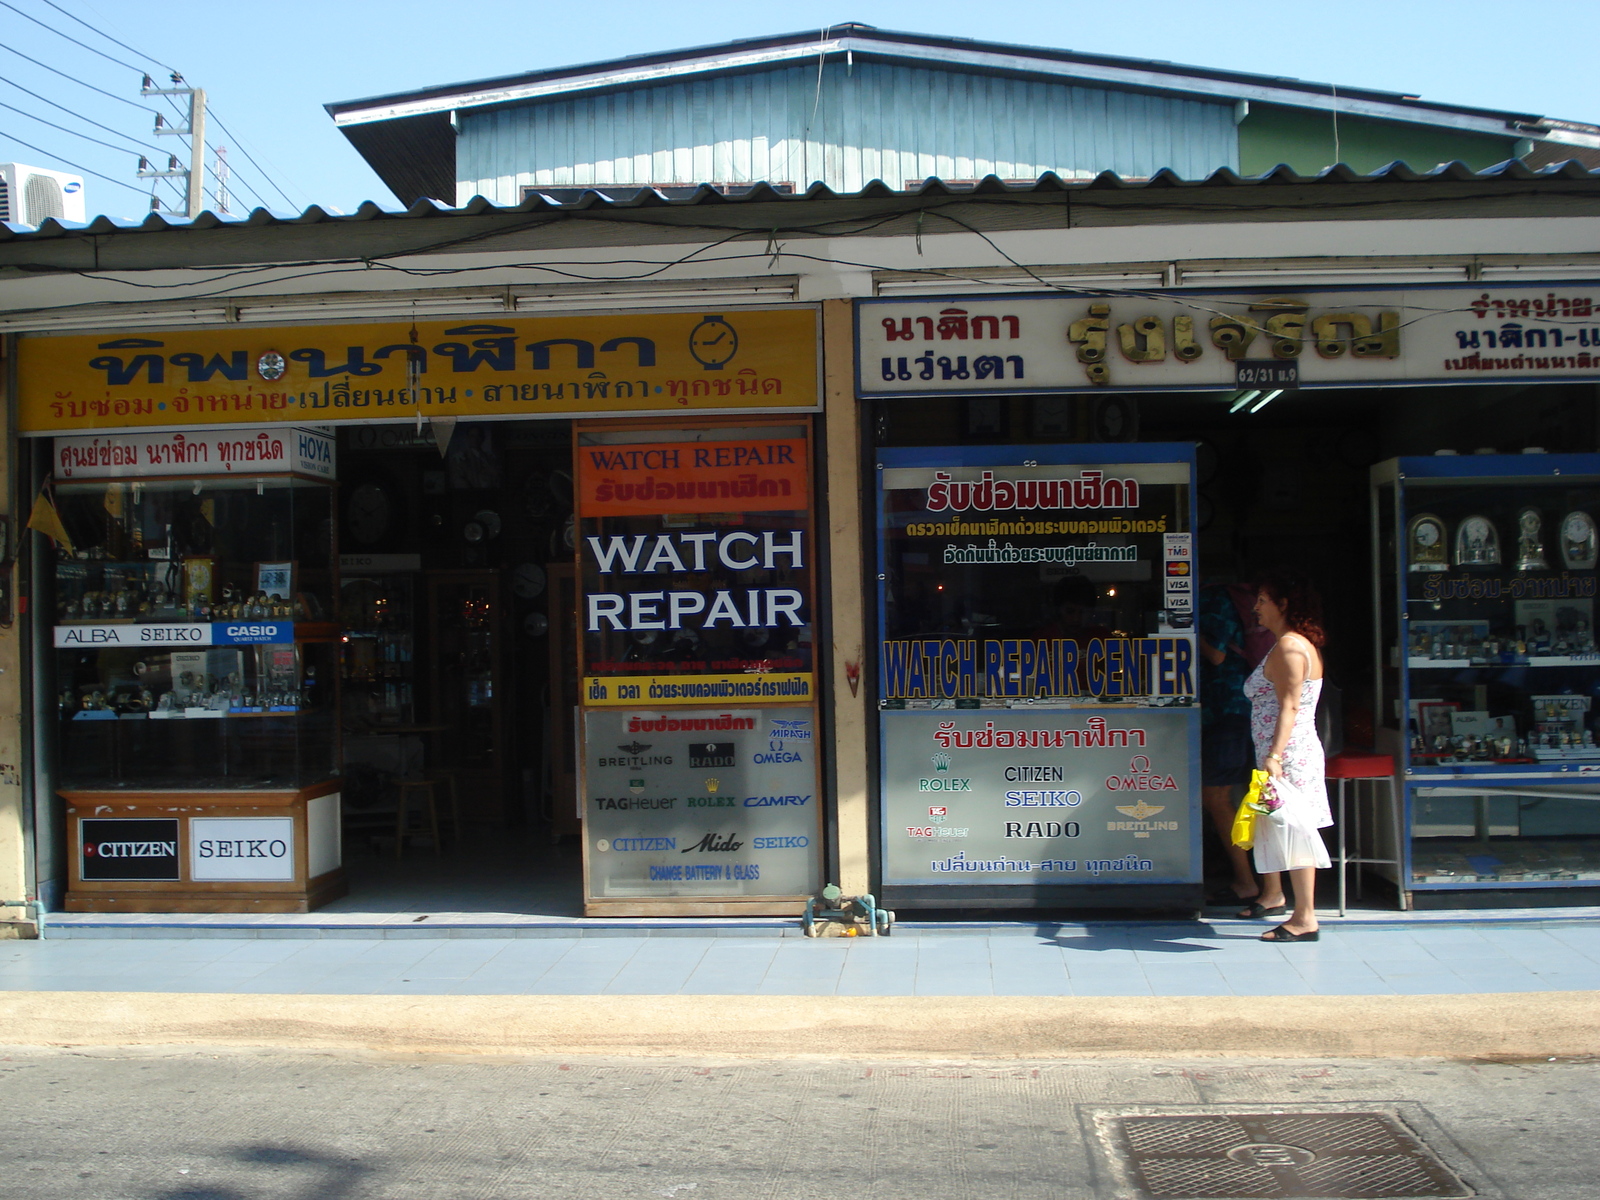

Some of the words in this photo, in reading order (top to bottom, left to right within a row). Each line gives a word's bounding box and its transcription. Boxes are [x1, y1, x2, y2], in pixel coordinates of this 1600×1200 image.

[882, 309, 1020, 342] นาฬิกา
[89, 338, 249, 386] ทิพ
[289, 324, 656, 378] นาฬิกา
[881, 350, 1024, 381] แว่นตา
[1238, 368, 1274, 384] 62/31
[50, 391, 153, 419] รับซ่อม
[172, 386, 288, 414] จำหน่าย
[483, 371, 649, 402] สายนาฬิกา
[666, 368, 783, 406] ทุกชนิด
[60, 438, 138, 477] ศูนย์ซ่อม
[147, 433, 208, 465] นาฬิกา
[218, 432, 284, 471] ทุกชนิด
[299, 434, 331, 464] HOYA
[590, 449, 680, 471] WATCH
[693, 444, 795, 467] REPAIR
[595, 474, 791, 502] รับซ่อมนาฬิกา
[926, 470, 1140, 512] รับซ่อมนาฬิกา
[586, 530, 804, 573] WATCH
[1167, 547, 1188, 556] TMB
[1169, 581, 1189, 589] VISA
[587, 589, 805, 631] REPAIR
[1169, 598, 1189, 606] VISA
[64, 628, 120, 643] ALBA
[140, 627, 203, 642] SEIKO
[227, 625, 277, 637] CASIO
[883, 640, 978, 698] WATCH
[984, 638, 1082, 698] REPAIR
[1086, 637, 1194, 698] CENTER
[618, 684, 641, 699] เวลา
[629, 714, 754, 733] รับซ่อมนาฬิกา
[933, 716, 1146, 749] รับซ่อมนาฬิกา
[599, 755, 673, 767] BREITLING
[690, 756, 735, 766] RADO
[753, 752, 802, 764] OMEGA
[919, 778, 972, 791] ROLEX
[1105, 775, 1178, 791] OMEGA
[1004, 766, 1064, 783] CITIZEN
[687, 797, 736, 807] ROLEX
[743, 795, 811, 807] CAMRY
[1005, 790, 1082, 807] SEIKO
[1004, 821, 1081, 838] RADO
[1106, 821, 1178, 832] BREITLING
[98, 841, 176, 858] CITIZEN
[199, 839, 287, 858] SEIKO
[613, 837, 676, 851] CITIZEN
[681, 832, 744, 854] Mido
[753, 836, 809, 849] SEIKO
[649, 865, 682, 881] CHANGE
[725, 864, 731, 880] &
[734, 864, 760, 880] GLASS
[931, 850, 1077, 873] เปลี่ยนถ่าน-สาย
[1084, 853, 1153, 877] ทุกชนิด
